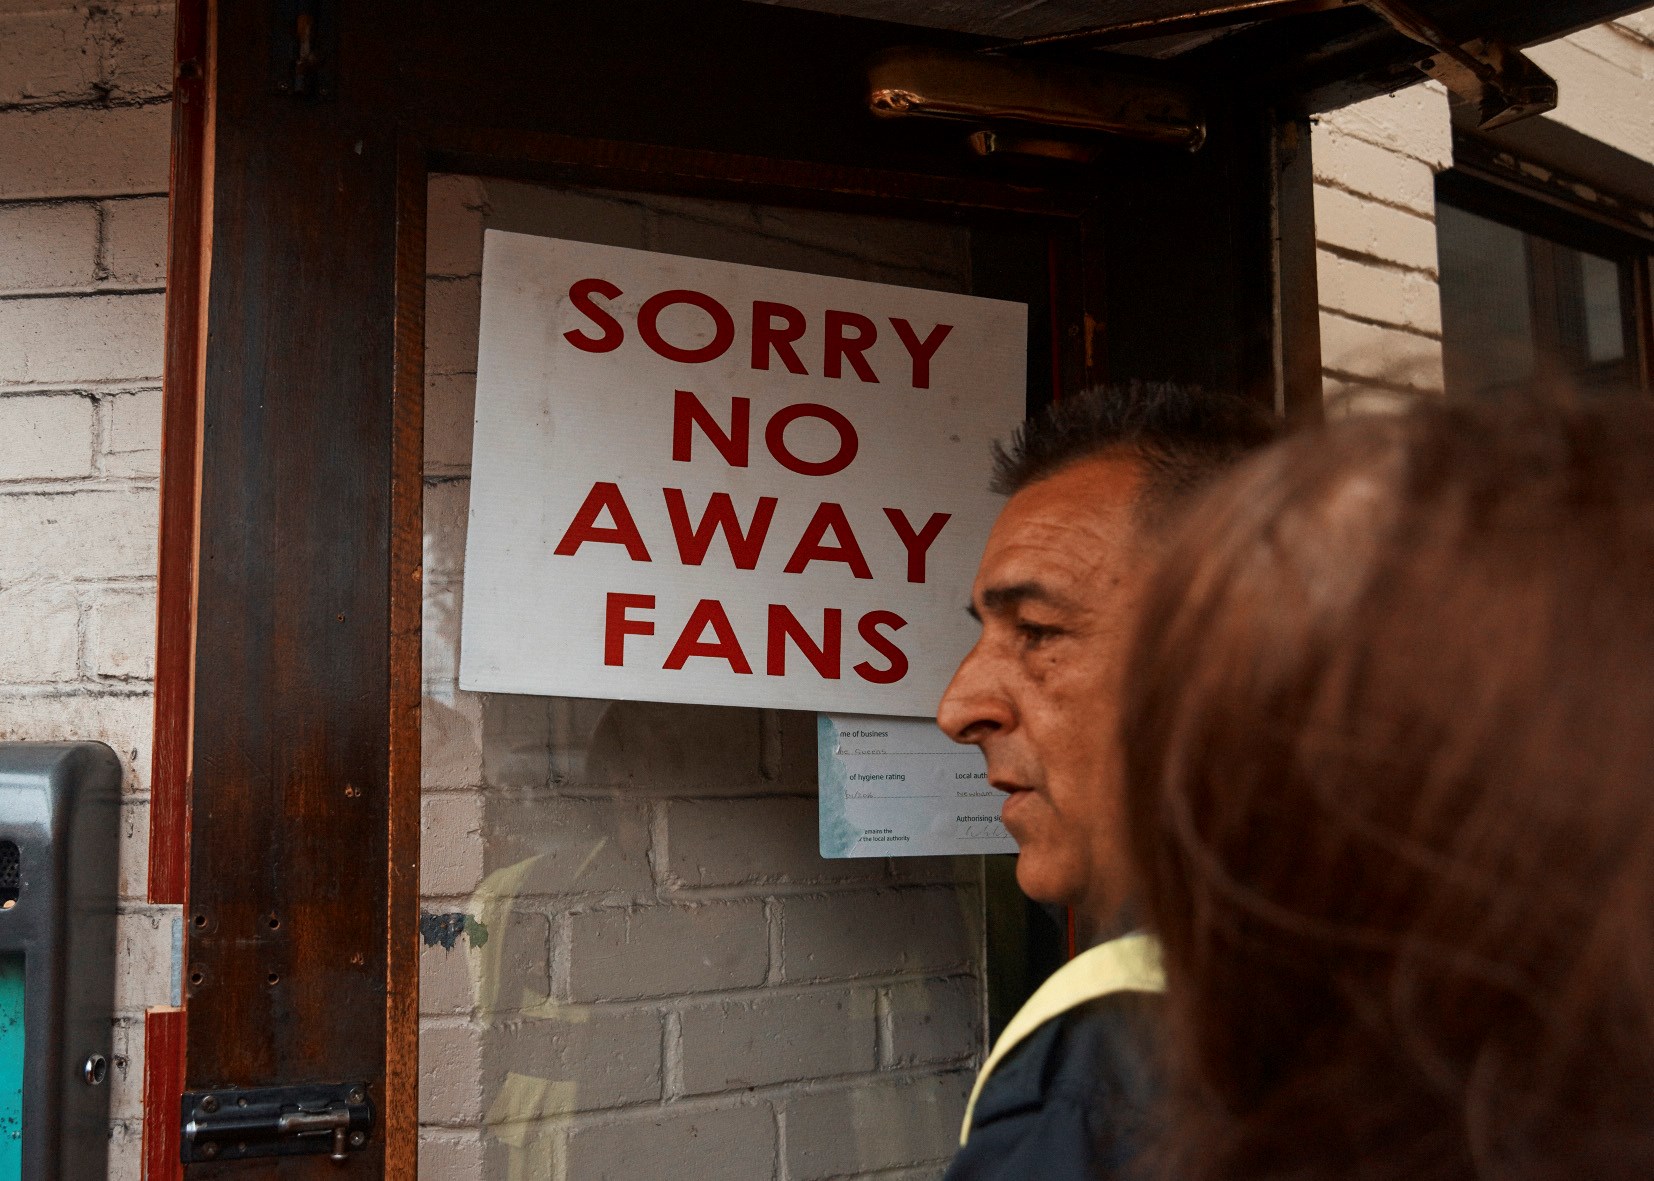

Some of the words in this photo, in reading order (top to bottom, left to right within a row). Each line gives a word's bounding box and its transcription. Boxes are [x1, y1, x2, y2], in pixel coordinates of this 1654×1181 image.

[563, 278, 953, 389] SORRY
[672, 390, 858, 476] NO
[553, 482, 952, 583] AWAY
[604, 592, 908, 684] FANS
[852, 730, 859, 738] of
[860, 730, 889, 738] business
[849, 773, 857, 781] of
[857, 773, 884, 782] hygiene
[885, 773, 906, 782] rating
[955, 772, 972, 780] Local
[956, 814, 993, 823] Authorising
[993, 814, 1003, 823] sig
